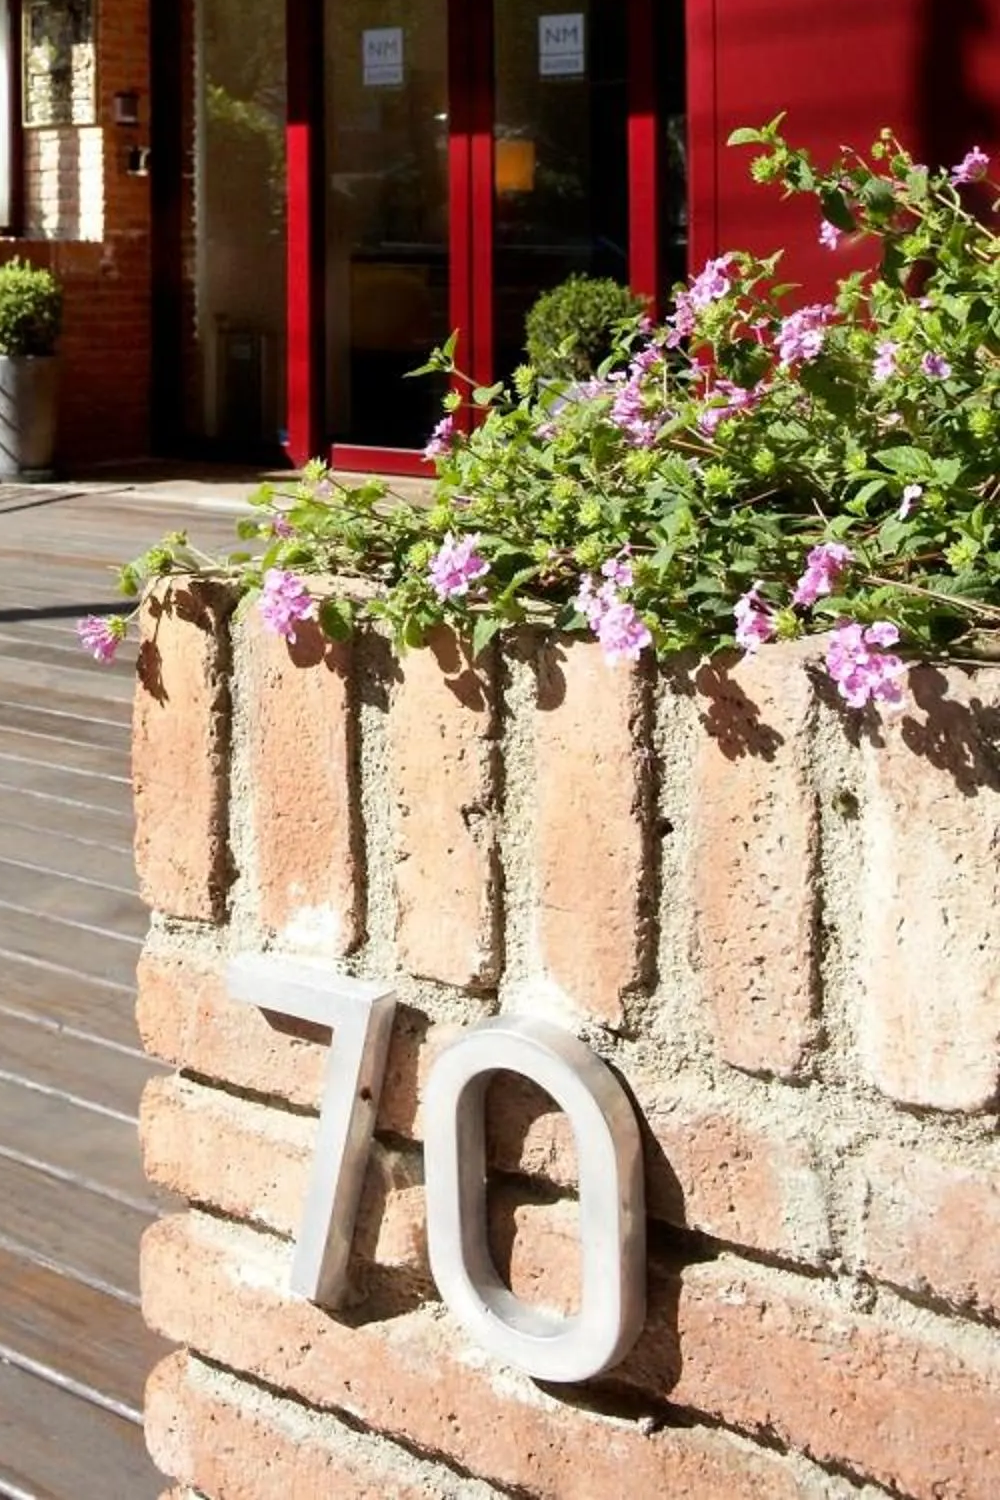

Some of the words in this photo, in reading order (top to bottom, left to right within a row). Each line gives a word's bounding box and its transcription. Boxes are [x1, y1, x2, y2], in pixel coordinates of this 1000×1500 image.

[545, 25, 579, 46] NM
[368, 39, 398, 58] NM
[225, 954, 647, 1383] 70
